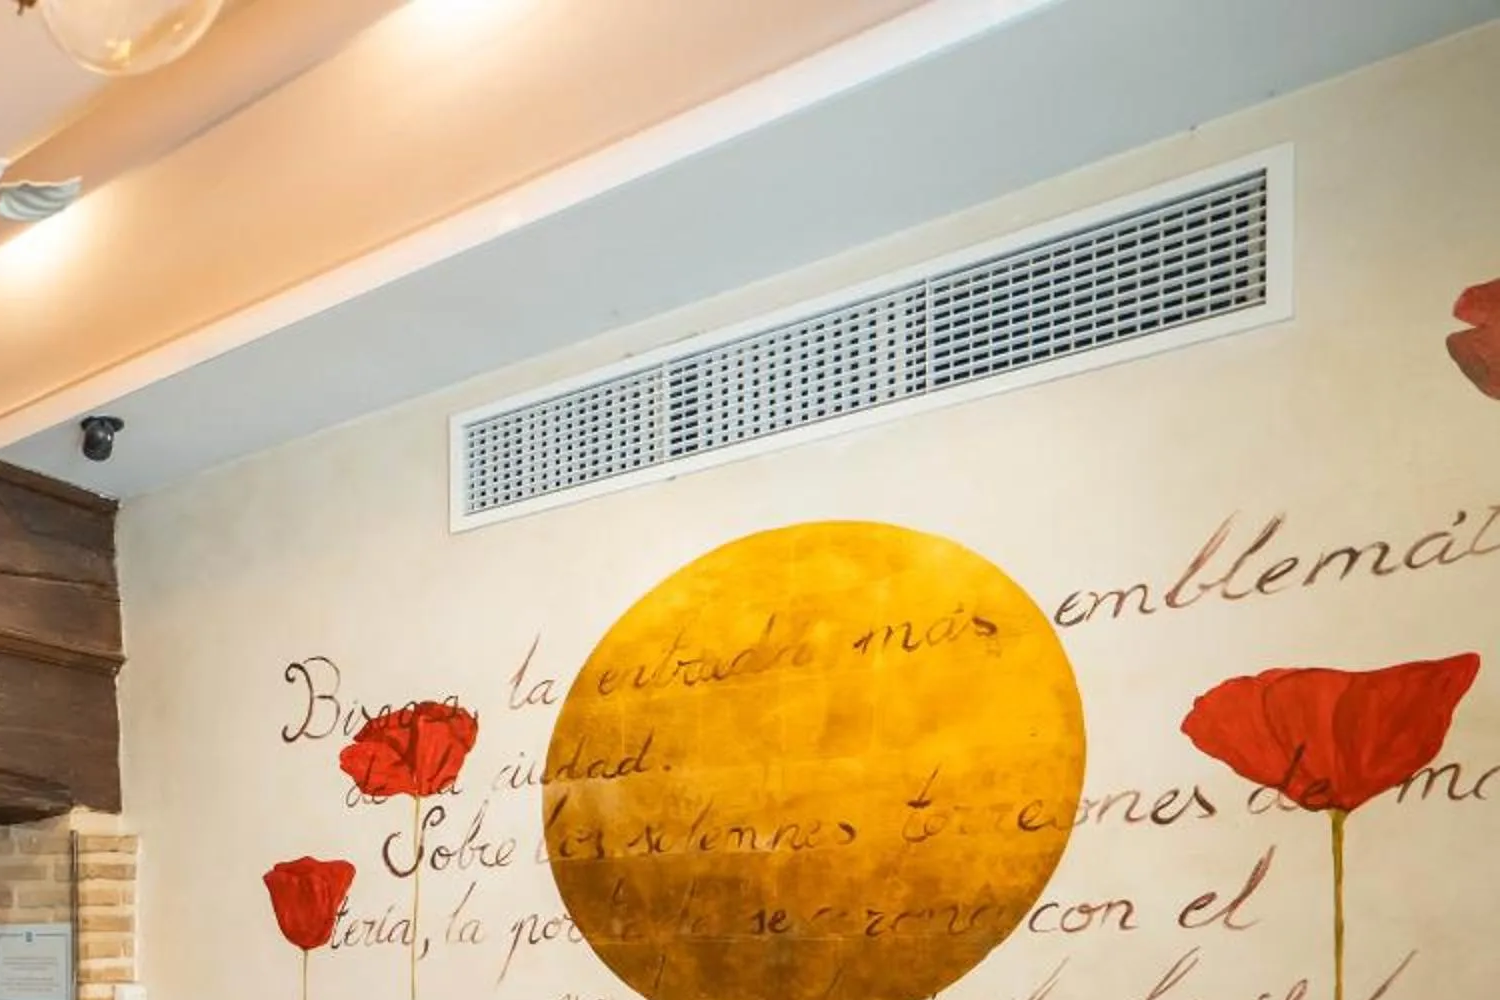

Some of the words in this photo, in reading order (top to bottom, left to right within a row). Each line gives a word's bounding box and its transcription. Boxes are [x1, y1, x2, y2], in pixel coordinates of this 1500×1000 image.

[507, 632, 558, 713] la
[597, 613, 814, 697] entrada
[852, 603, 998, 655] más
[498, 734, 675, 792] ciudad.
[382, 800, 518, 879] Sobre
[444, 880, 487, 946] la
[749, 907, 791, 937] se
[1026, 897, 1139, 935] con
[1177, 844, 1276, 932] el
